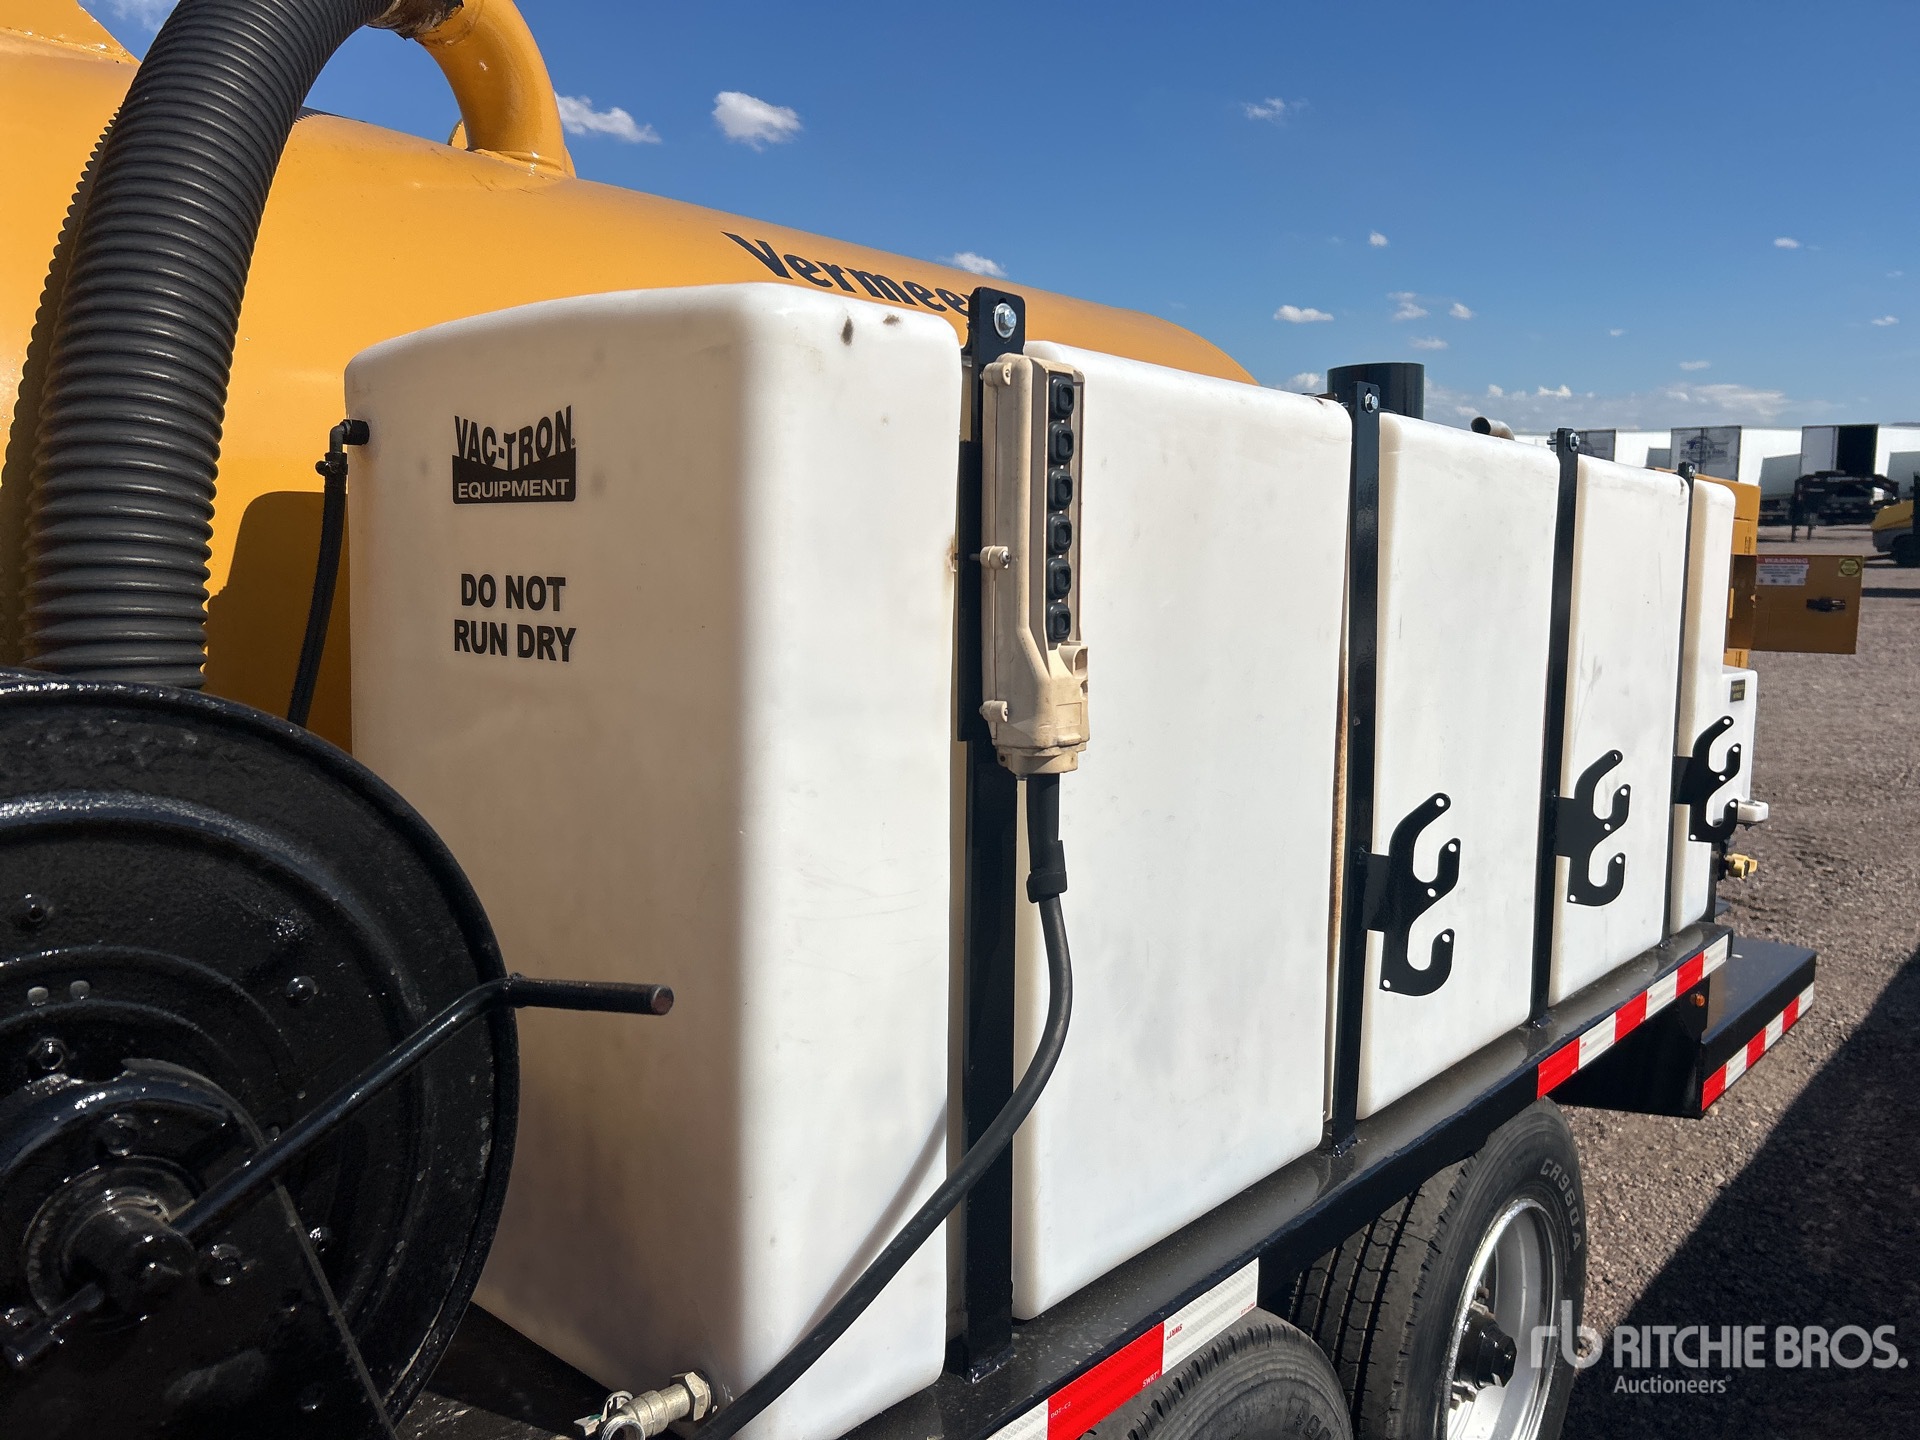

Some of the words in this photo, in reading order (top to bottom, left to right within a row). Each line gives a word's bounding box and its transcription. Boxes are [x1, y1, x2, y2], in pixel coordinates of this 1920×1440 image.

[721, 231, 970, 317] Vermee
[458, 478, 570, 500] EQUIPMENT
[461, 573, 497, 608] DO
[505, 575, 566, 612] NOT
[454, 619, 508, 656] RUN
[517, 623, 577, 662] DRY
